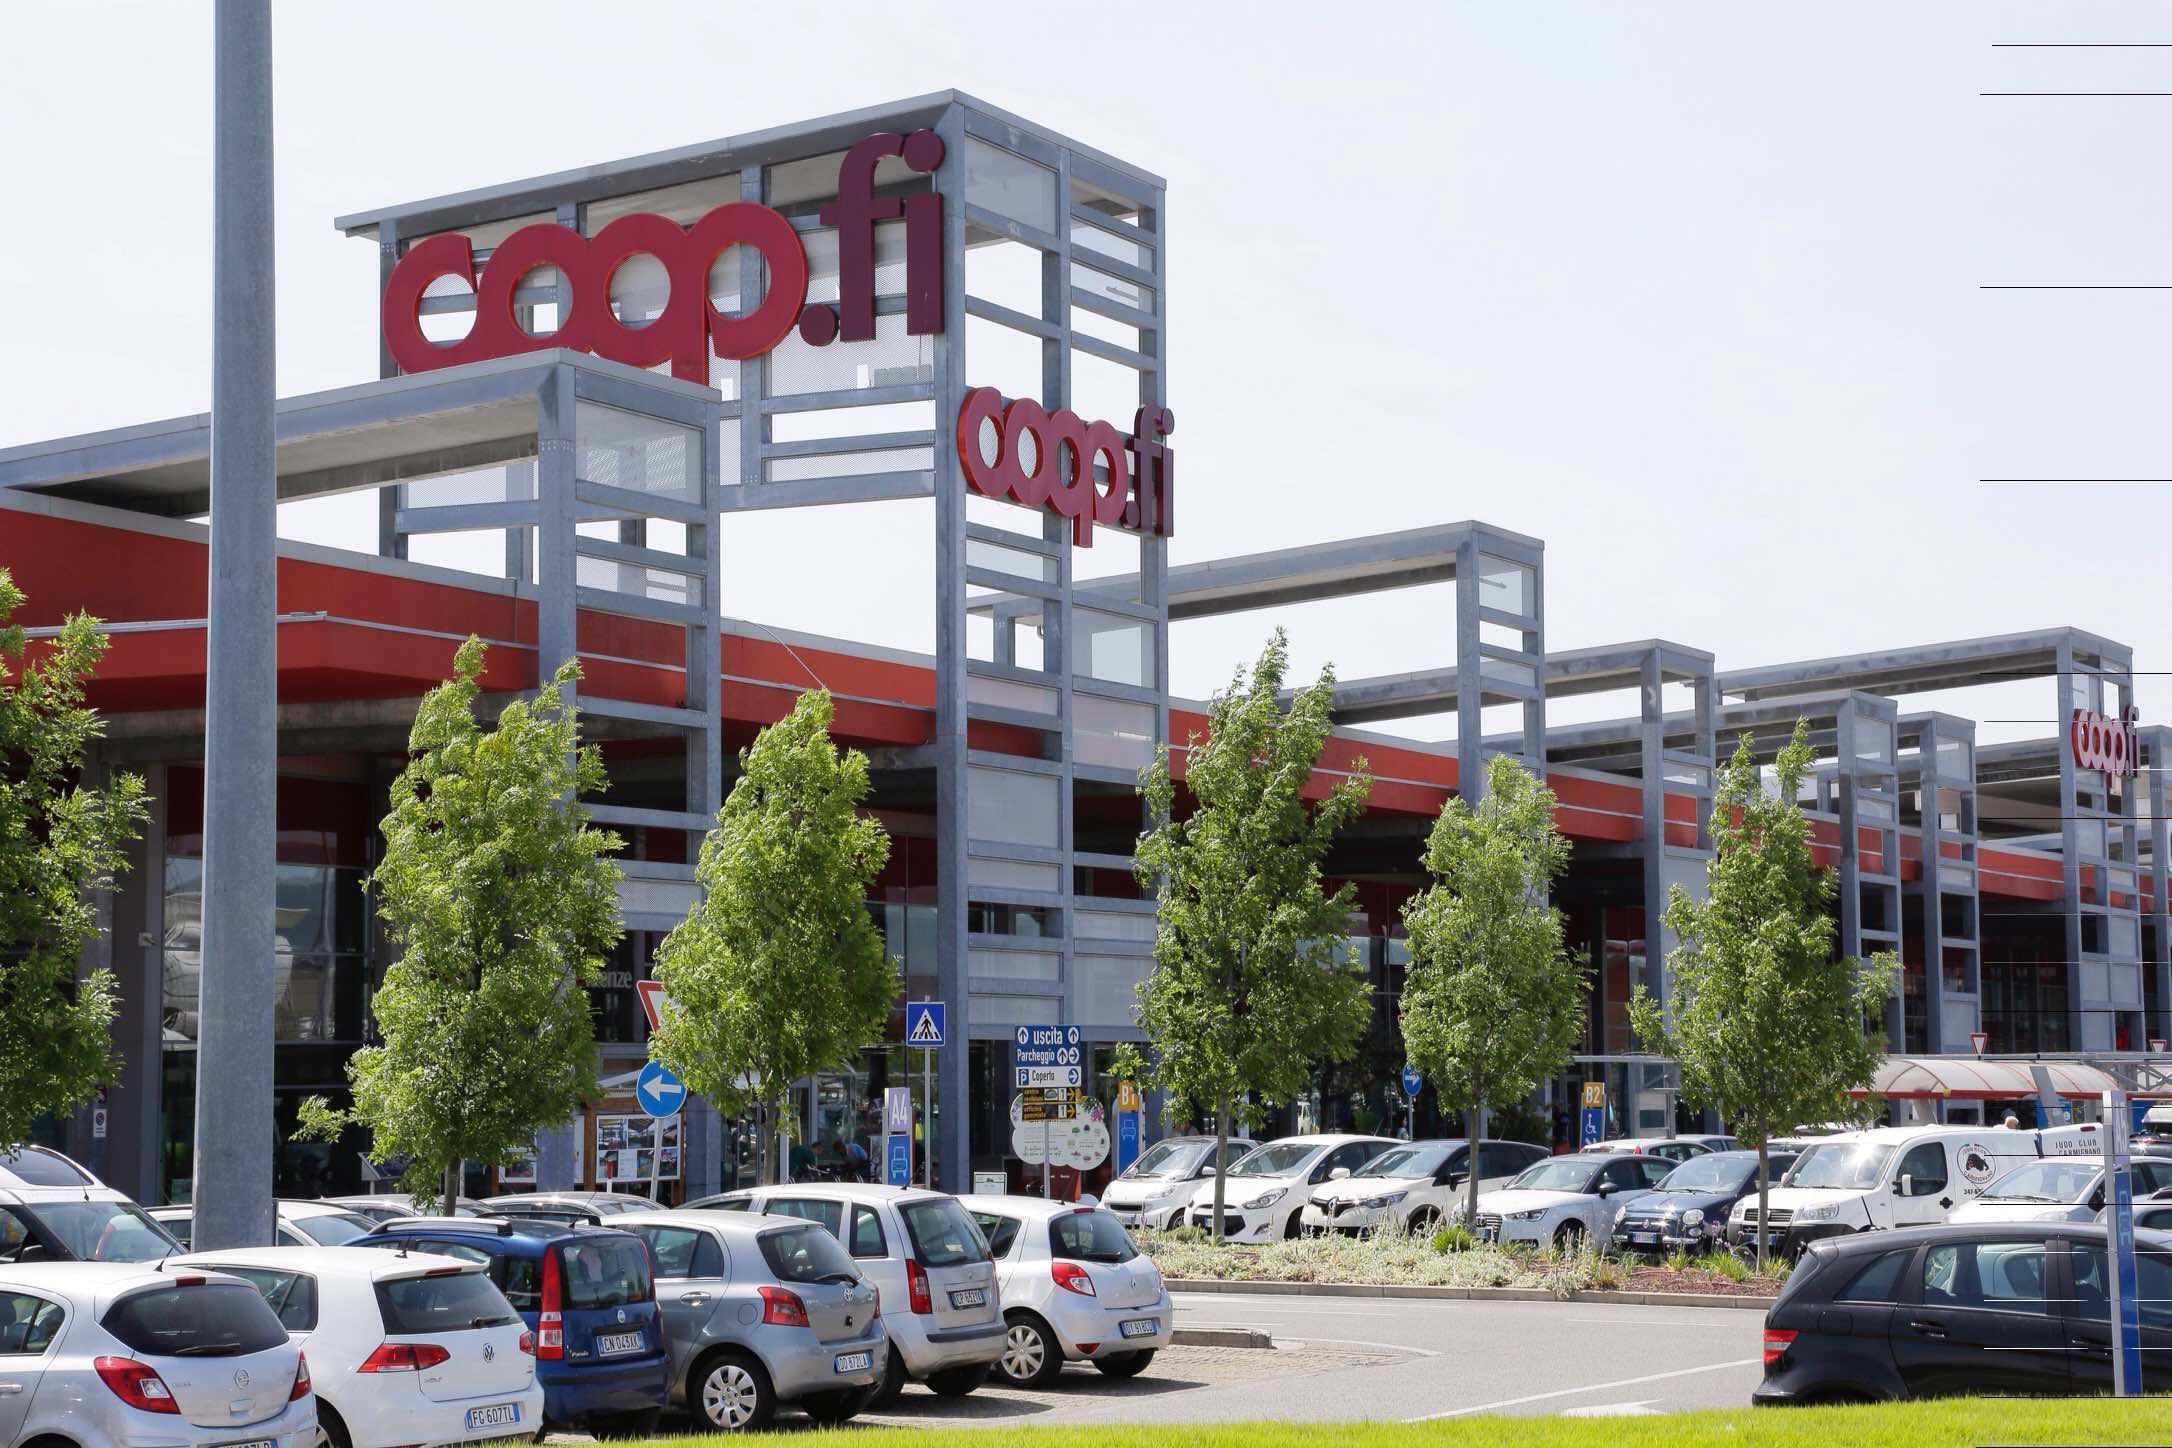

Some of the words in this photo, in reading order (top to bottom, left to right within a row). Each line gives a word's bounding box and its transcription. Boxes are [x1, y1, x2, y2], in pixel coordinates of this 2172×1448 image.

[1033, 1026, 1063, 1045] uscita
[1017, 1048, 1055, 1064] Parcheggio
[1031, 1070, 1055, 1083] Coperto
[1586, 1086, 1601, 1104] B2
[891, 1093, 908, 1125] A4
[472, 1410, 485, 1426] FG
[486, 1405, 514, 1424] 607TL
